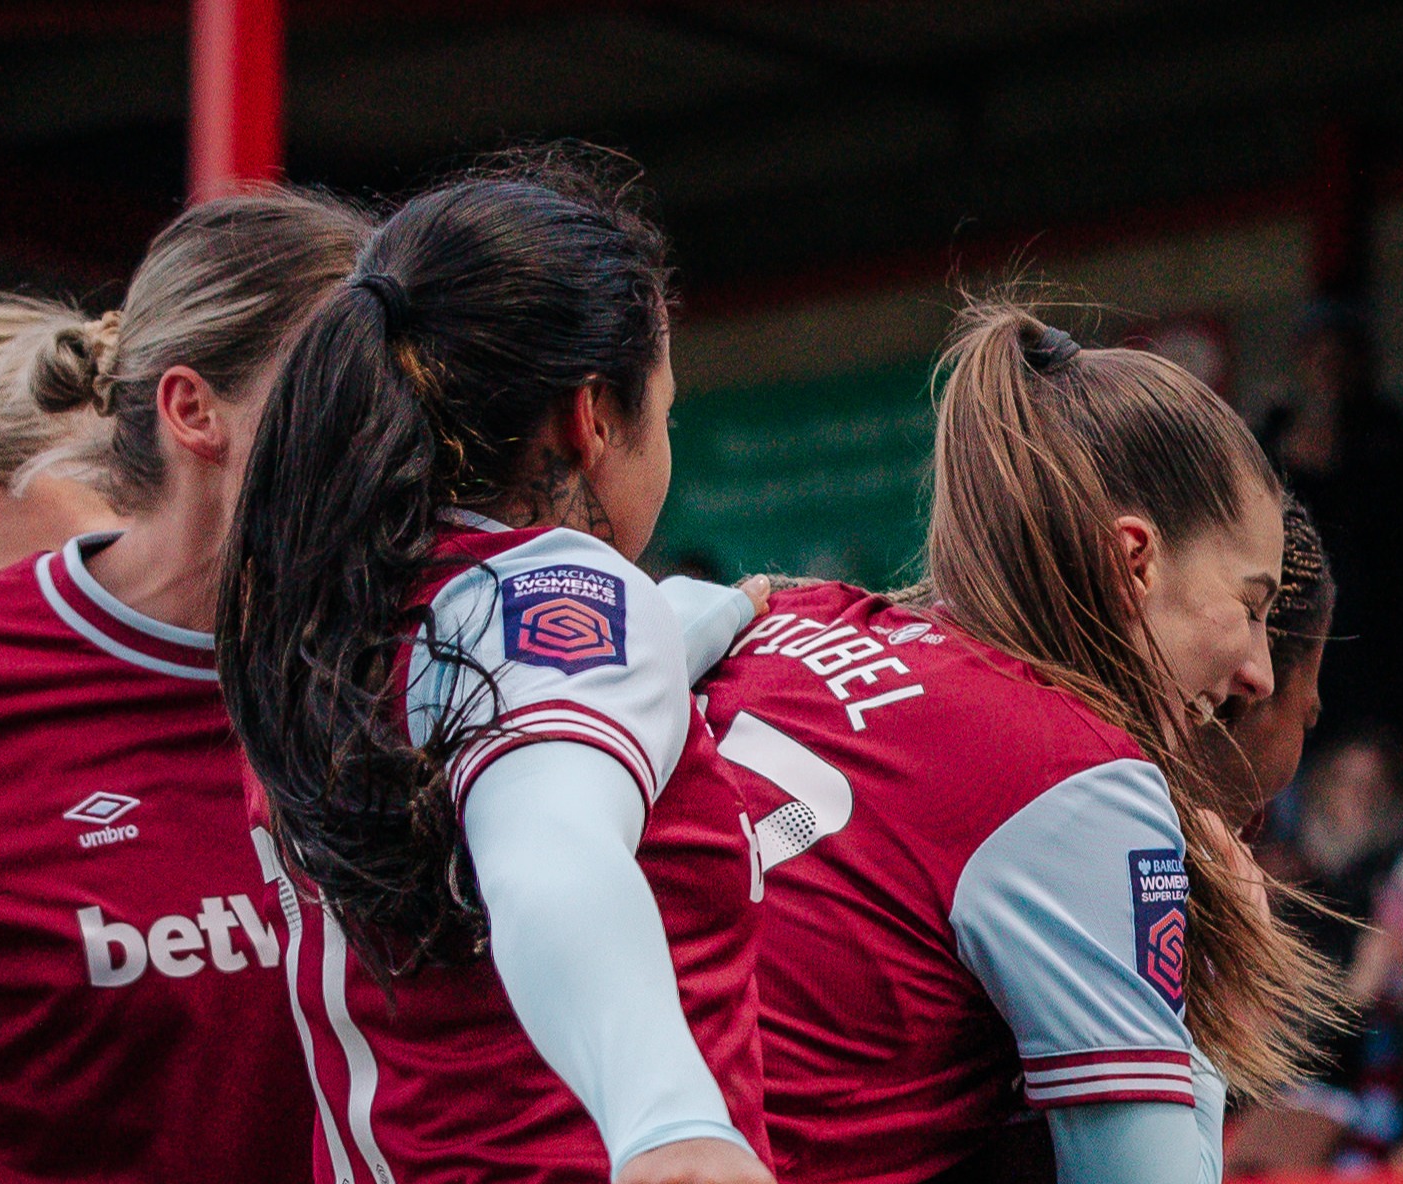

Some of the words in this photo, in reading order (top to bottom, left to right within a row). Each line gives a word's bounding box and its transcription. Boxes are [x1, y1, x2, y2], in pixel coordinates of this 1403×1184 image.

[513, 578, 615, 599] WOMEN'S
[535, 570, 615, 589] BARCLAYS
[514, 586, 560, 598] SUPER
[563, 587, 616, 606] LEAGUE
[729, 613, 925, 732] PIUBEL
[717, 709, 855, 874] 7
[78, 824, 139, 848] umbro
[1141, 891, 1172, 903] SUPER
